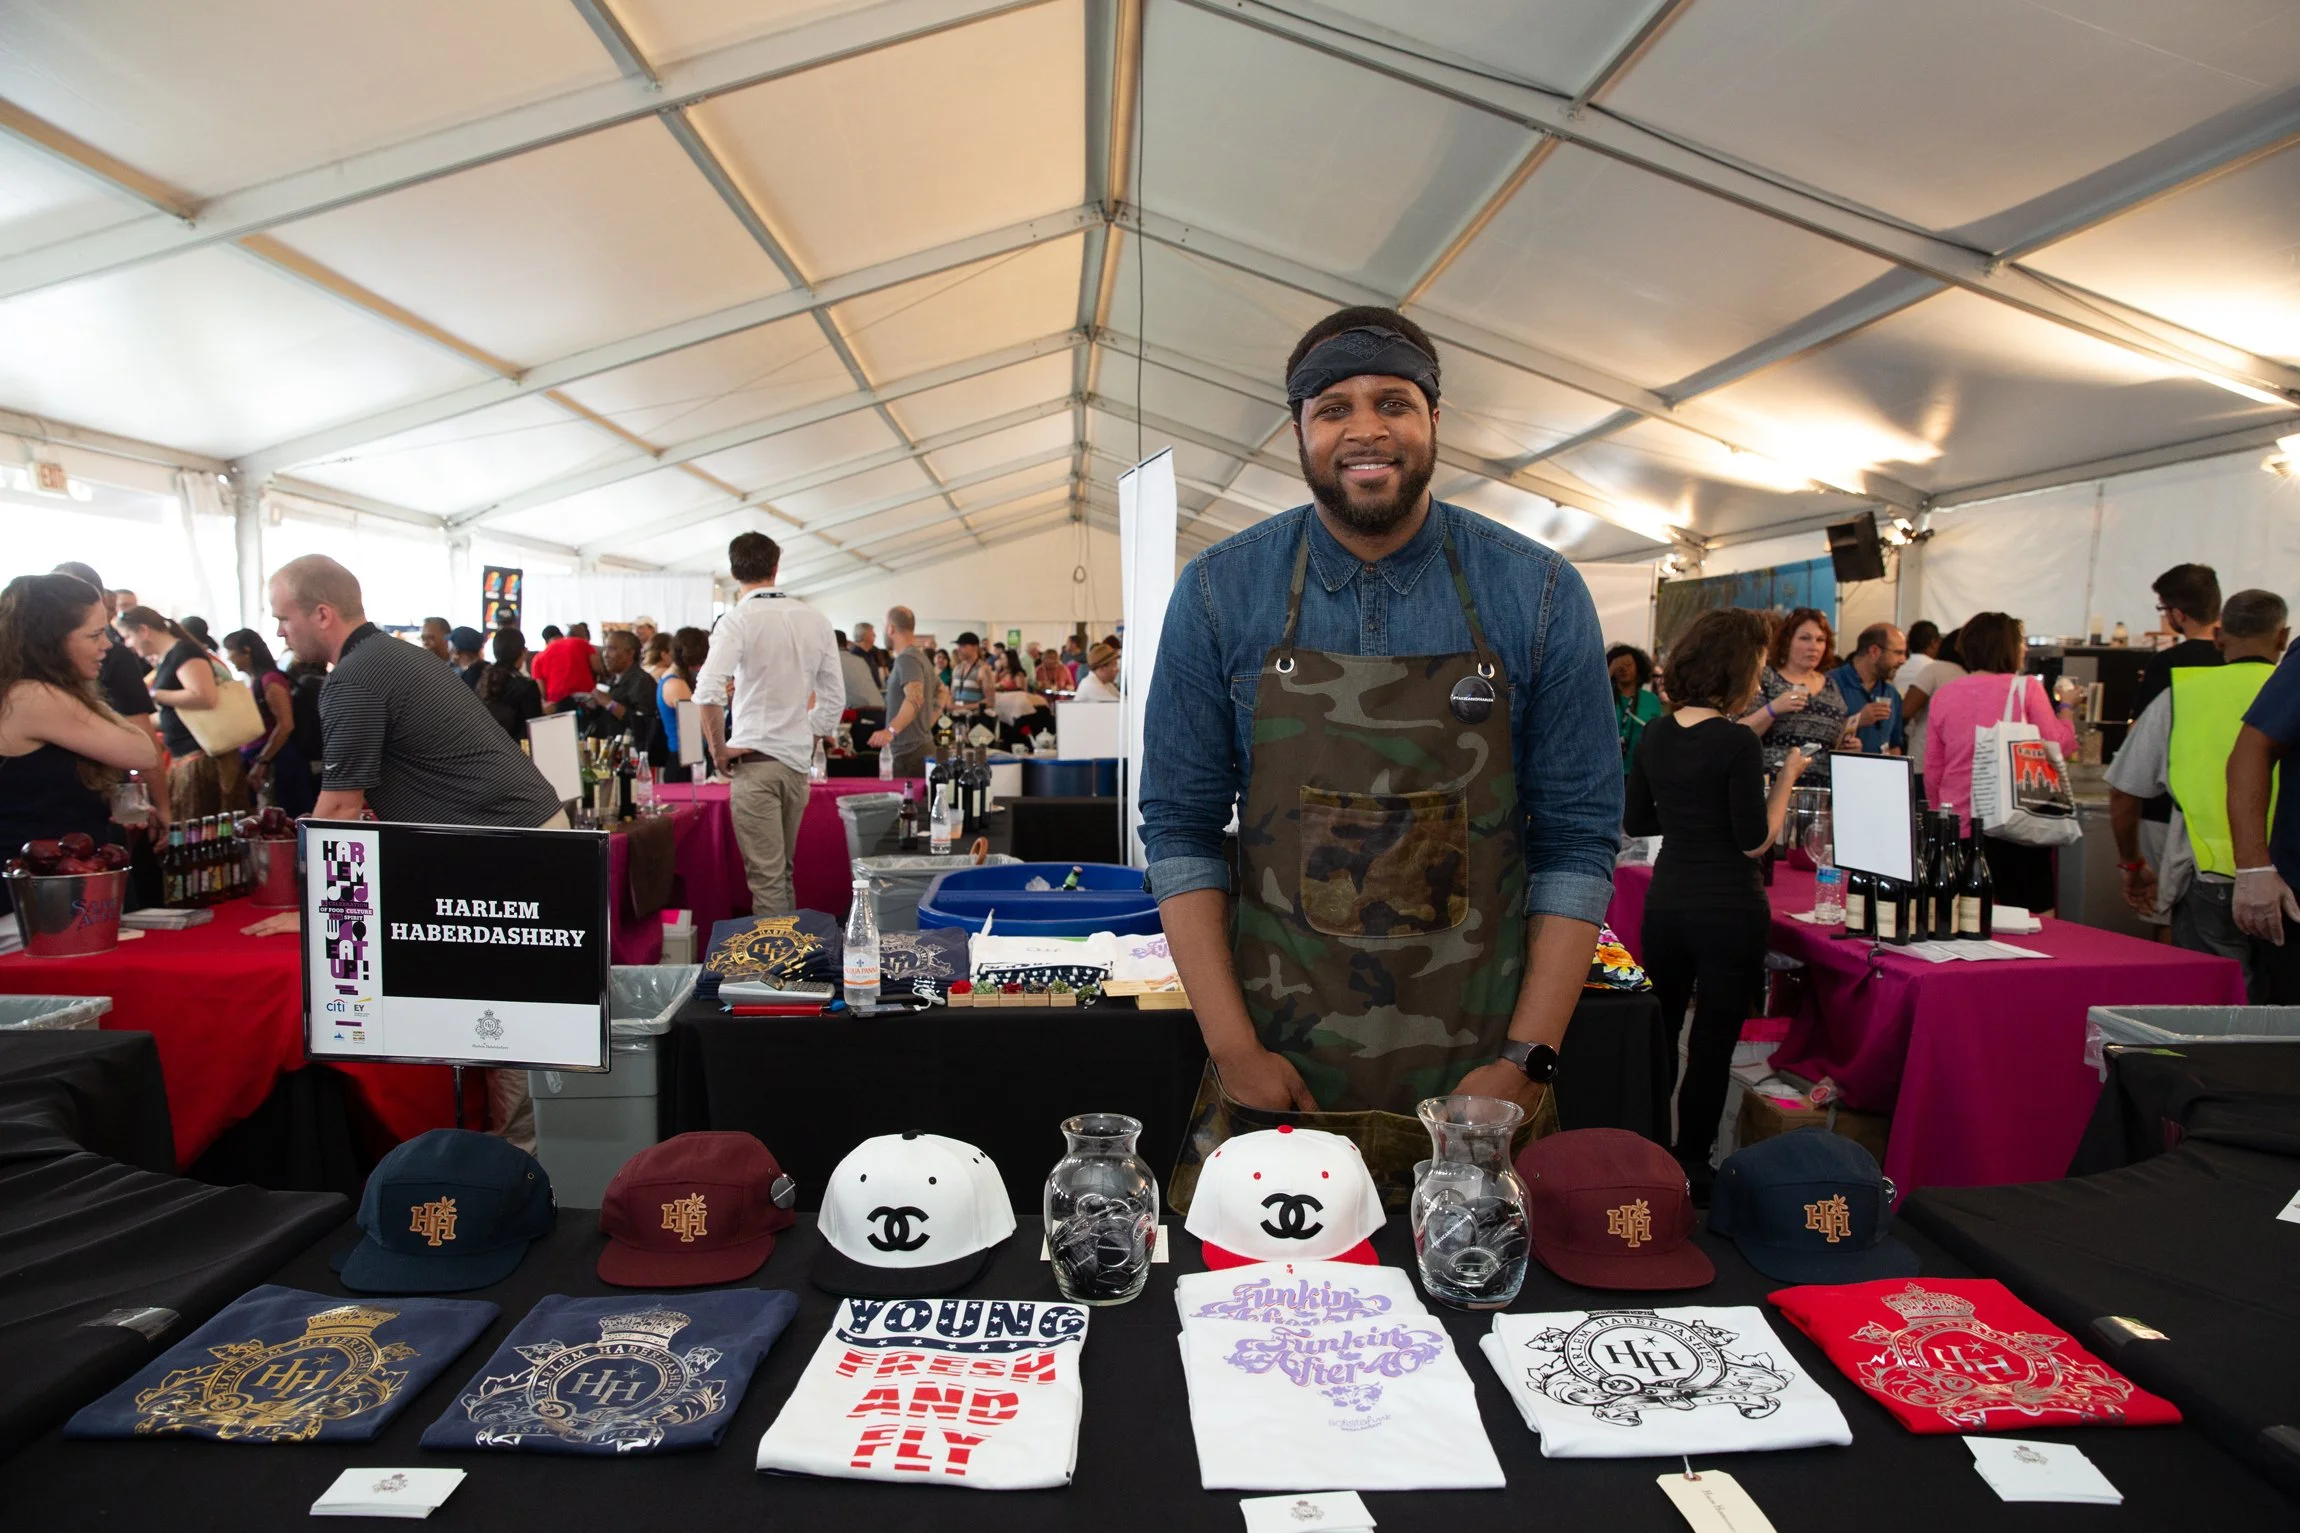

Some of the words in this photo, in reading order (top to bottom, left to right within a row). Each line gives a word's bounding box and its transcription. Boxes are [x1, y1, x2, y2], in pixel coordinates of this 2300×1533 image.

[435, 898, 540, 919] HARLEM
[390, 922, 586, 948] HABERDASHERY
[354, 1004, 365, 1012] EY
[848, 1299, 1086, 1339] YOUNG
[835, 1347, 1058, 1385] FRESH
[1573, 1329, 1598, 1378] HARLEM
[1596, 1317, 1720, 1372] HABERDASHERY
[1600, 1340, 1686, 1377] HH
[1929, 1345, 2021, 1381] HH
[250, 1358, 333, 1399] HH
[533, 1351, 588, 1397] HARLEM
[600, 1344, 682, 1402] HABERDASHERY
[566, 1369, 647, 1406] HH
[846, 1381, 1020, 1426] AND
[850, 1423, 993, 1476] FLY
